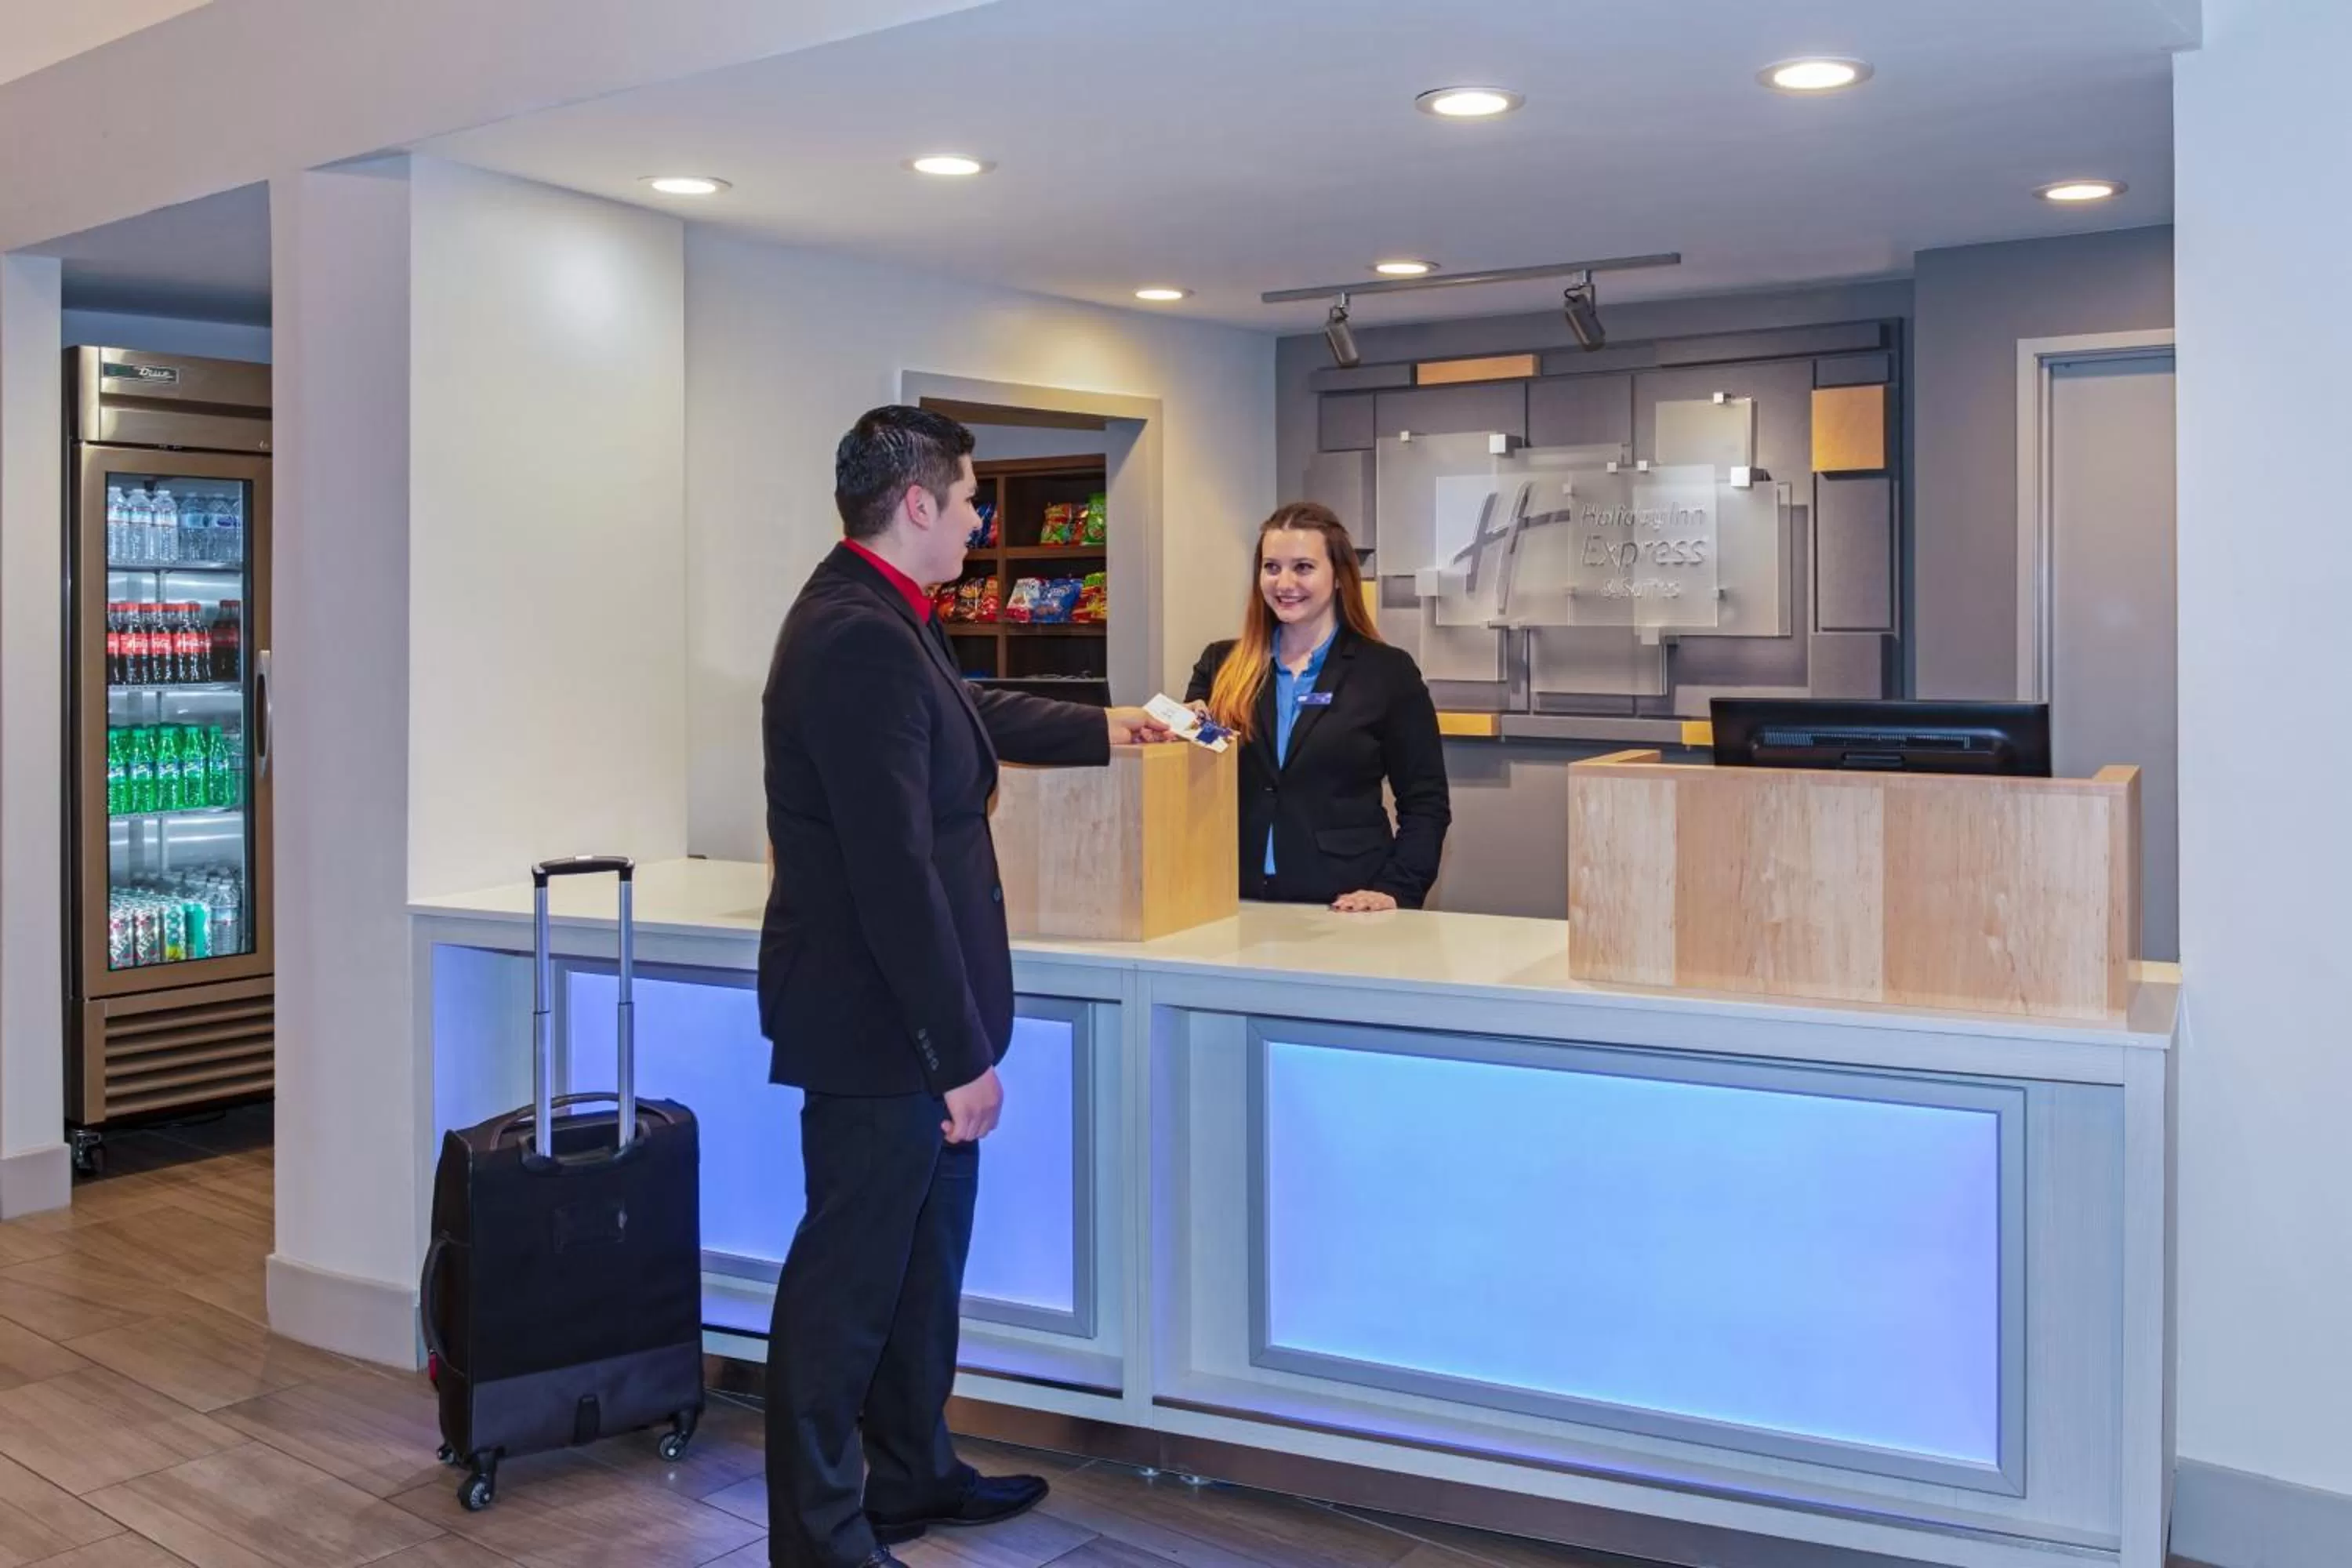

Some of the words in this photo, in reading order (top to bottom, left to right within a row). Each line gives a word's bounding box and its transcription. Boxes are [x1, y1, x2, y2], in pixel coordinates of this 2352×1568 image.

[1581, 502, 1664, 532] Holiday
[1668, 501, 1706, 525] Inn
[1581, 535, 1709, 574] Express
